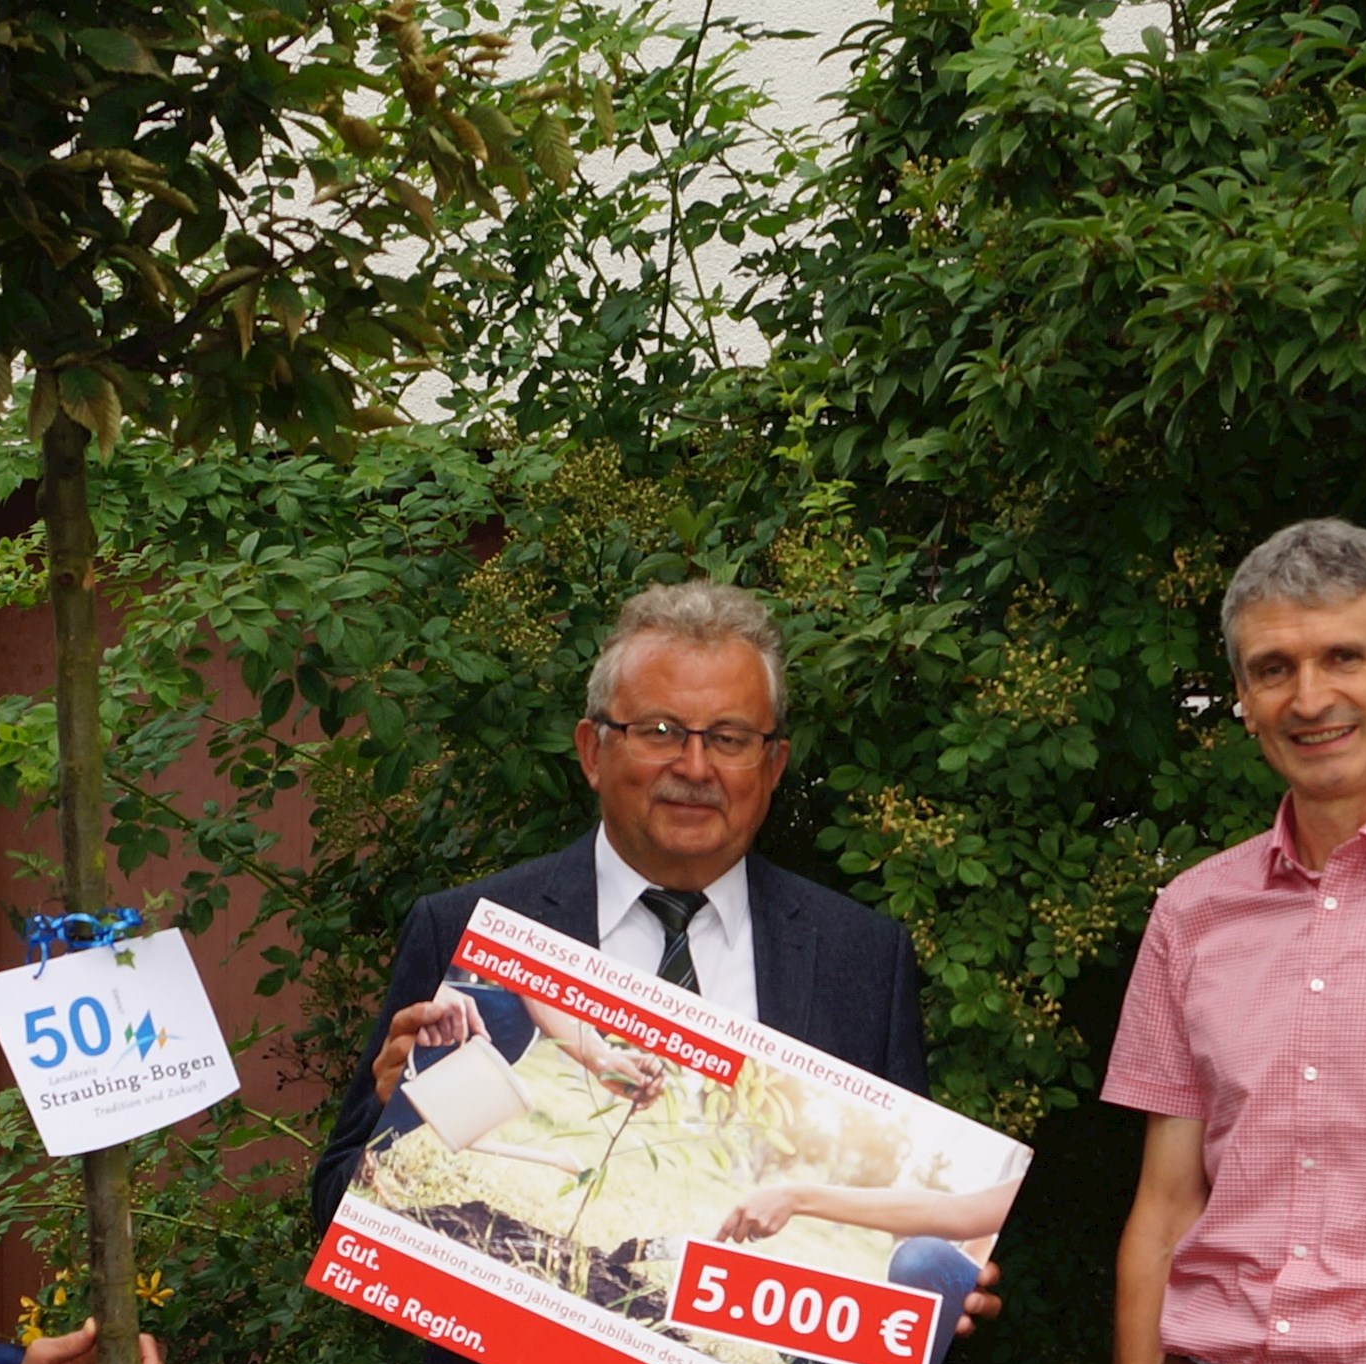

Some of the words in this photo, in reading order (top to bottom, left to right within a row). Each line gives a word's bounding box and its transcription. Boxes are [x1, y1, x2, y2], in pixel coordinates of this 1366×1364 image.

[24, 996, 112, 1069] 50
[461, 939, 560, 1000] Landkreis
[561, 985, 732, 1078] Straubing-Bogen
[479, 909, 581, 967] Sparkasse
[585, 956, 777, 1056] Niederbayern-Mitte
[781, 1048, 896, 1111] unterstützt:
[39, 1054, 216, 1110] Straubing-Bogen
[48, 1066, 99, 1087] Landkreis
[93, 1097, 143, 1118] Tradition
[144, 1090, 165, 1105] und
[166, 1079, 207, 1098] Zukunft
[336, 1234, 380, 1271] Gut.
[338, 1203, 469, 1271] Baumpflanzaktion
[470, 1262, 502, 1286] zum
[504, 1277, 586, 1325] 50-jährigen
[588, 1317, 655, 1356] Jubiläum
[321, 1261, 362, 1294] Für
[362, 1281, 400, 1312] die
[401, 1298, 486, 1353] Region.
[691, 1264, 861, 1343] 5.000
[878, 1309, 920, 1357] €
